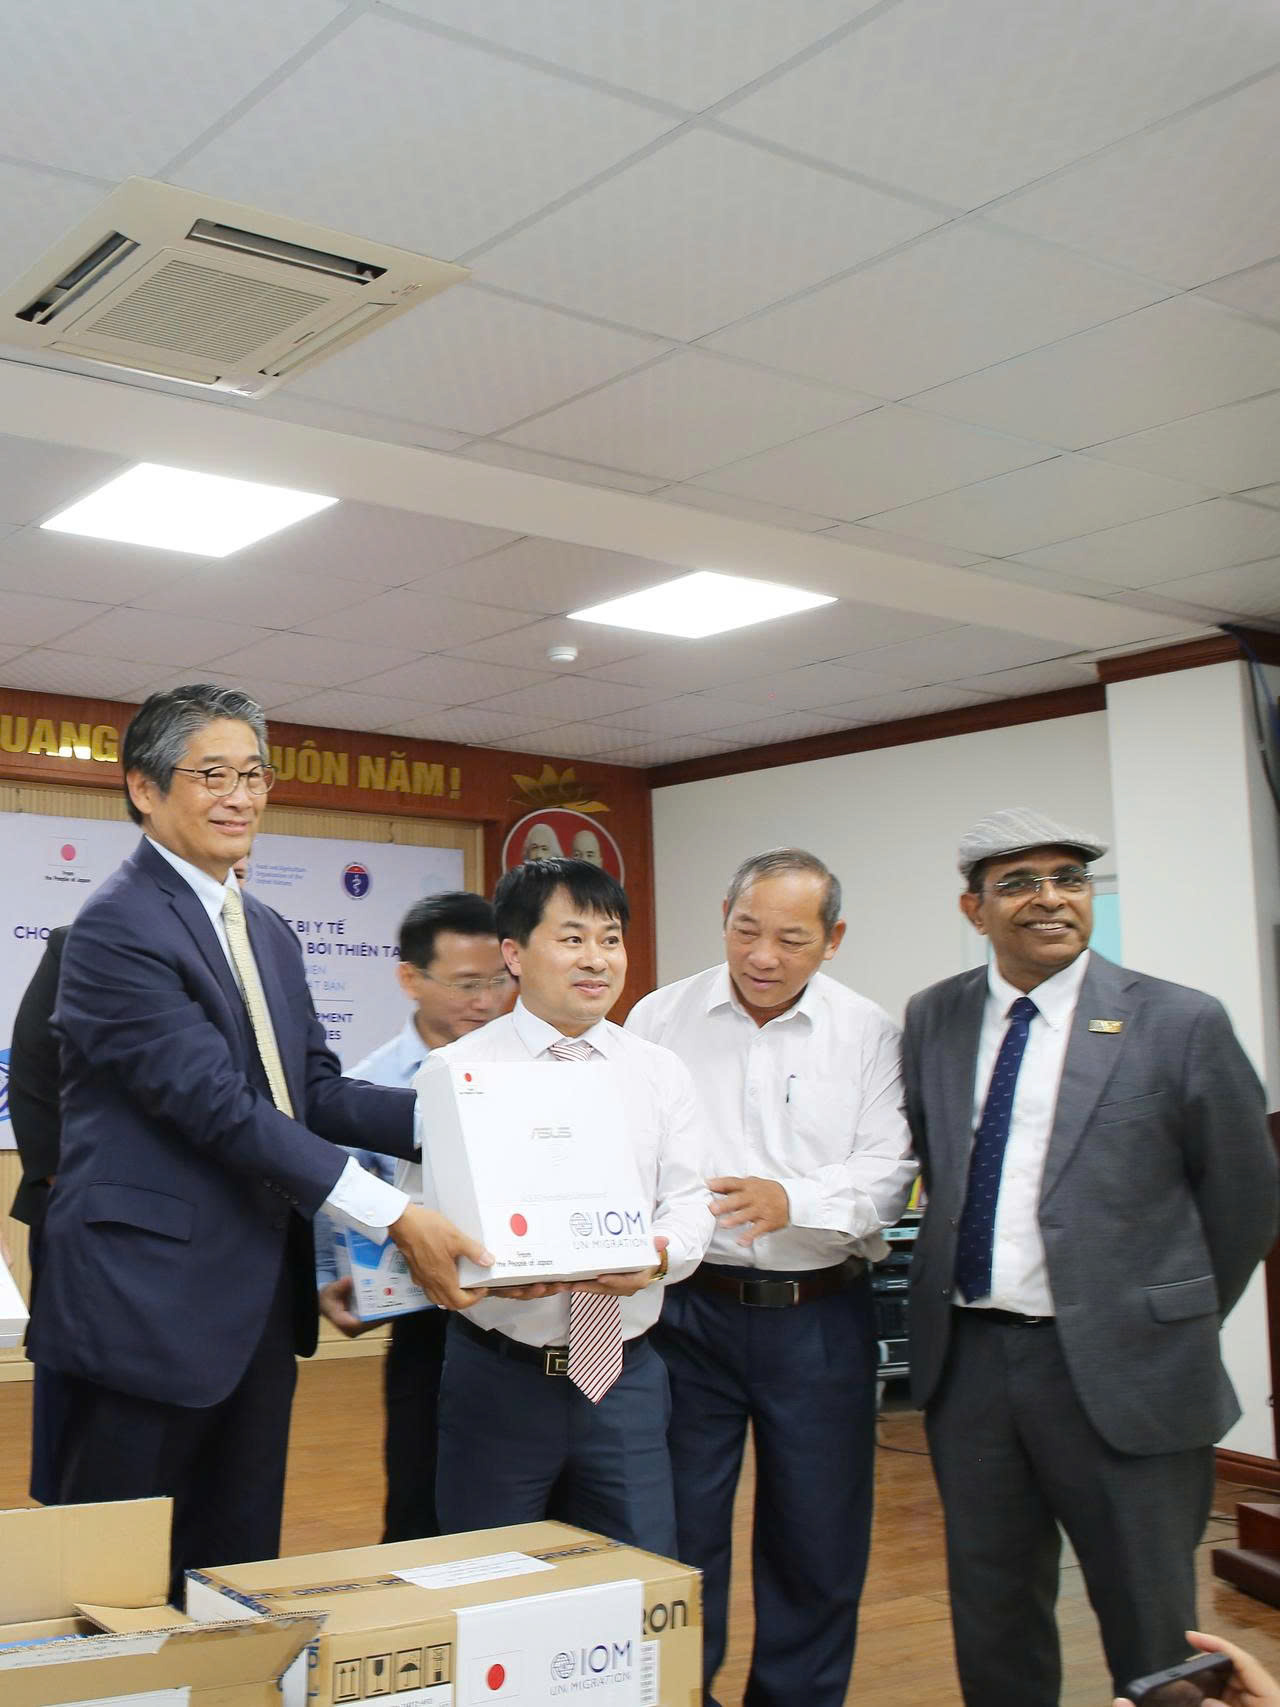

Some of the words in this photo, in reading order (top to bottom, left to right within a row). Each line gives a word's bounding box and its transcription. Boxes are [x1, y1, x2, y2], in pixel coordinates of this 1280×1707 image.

[314, 921, 324, 934] Y
[531, 1126, 573, 1140] ASUS
[595, 1210, 646, 1236] IOM
[591, 1238, 648, 1249] MIGRATION
[580, 1639, 632, 1676] IOM
[570, 1672, 632, 1693] MIGRATION
